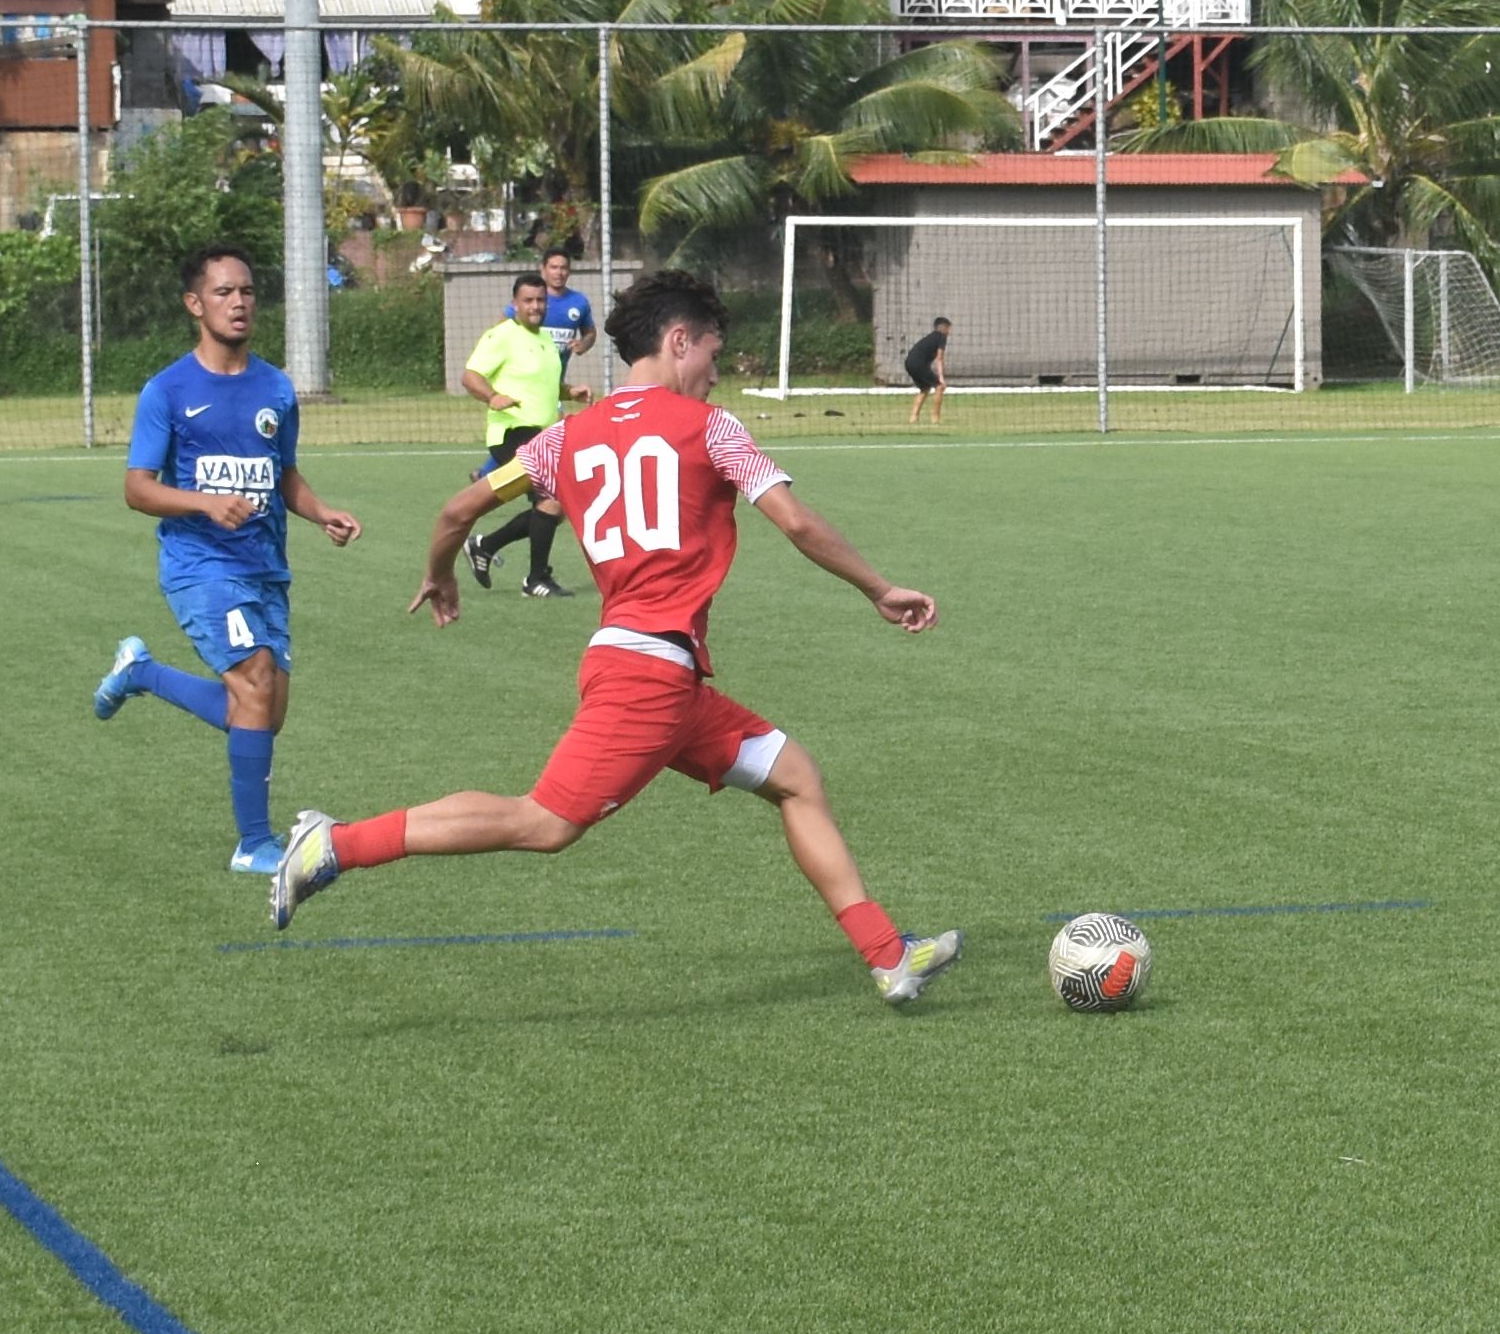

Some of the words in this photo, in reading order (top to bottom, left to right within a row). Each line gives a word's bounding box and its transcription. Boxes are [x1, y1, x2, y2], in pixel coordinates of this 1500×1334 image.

[201, 461, 271, 484] VAIMA
[574, 435, 681, 565] 20
[227, 609, 255, 649] 4
